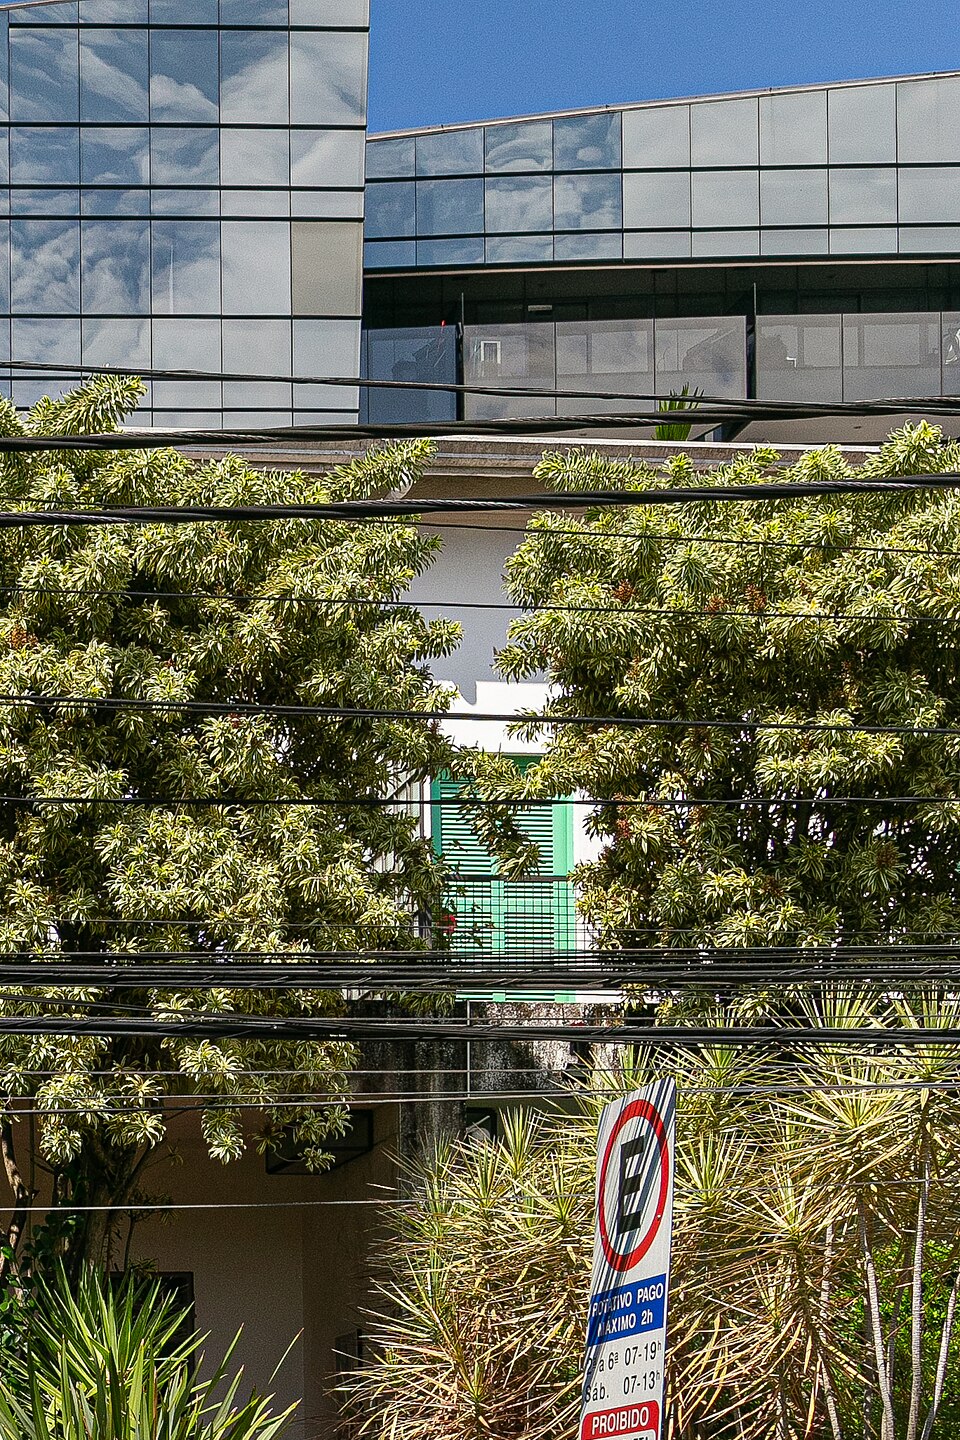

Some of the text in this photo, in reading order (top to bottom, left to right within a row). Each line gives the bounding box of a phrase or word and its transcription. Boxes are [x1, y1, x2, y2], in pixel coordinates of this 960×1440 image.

[617, 1134, 645, 1236] E
[592, 1283, 664, 1317] ROTATIVO PAGO
[597, 1309, 653, 1338] MÁXIMO 2h
[599, 1359, 605, 1372] a
[624, 1341, 662, 1366] 07-19h
[592, 1406, 649, 1435] PROIBIDO
